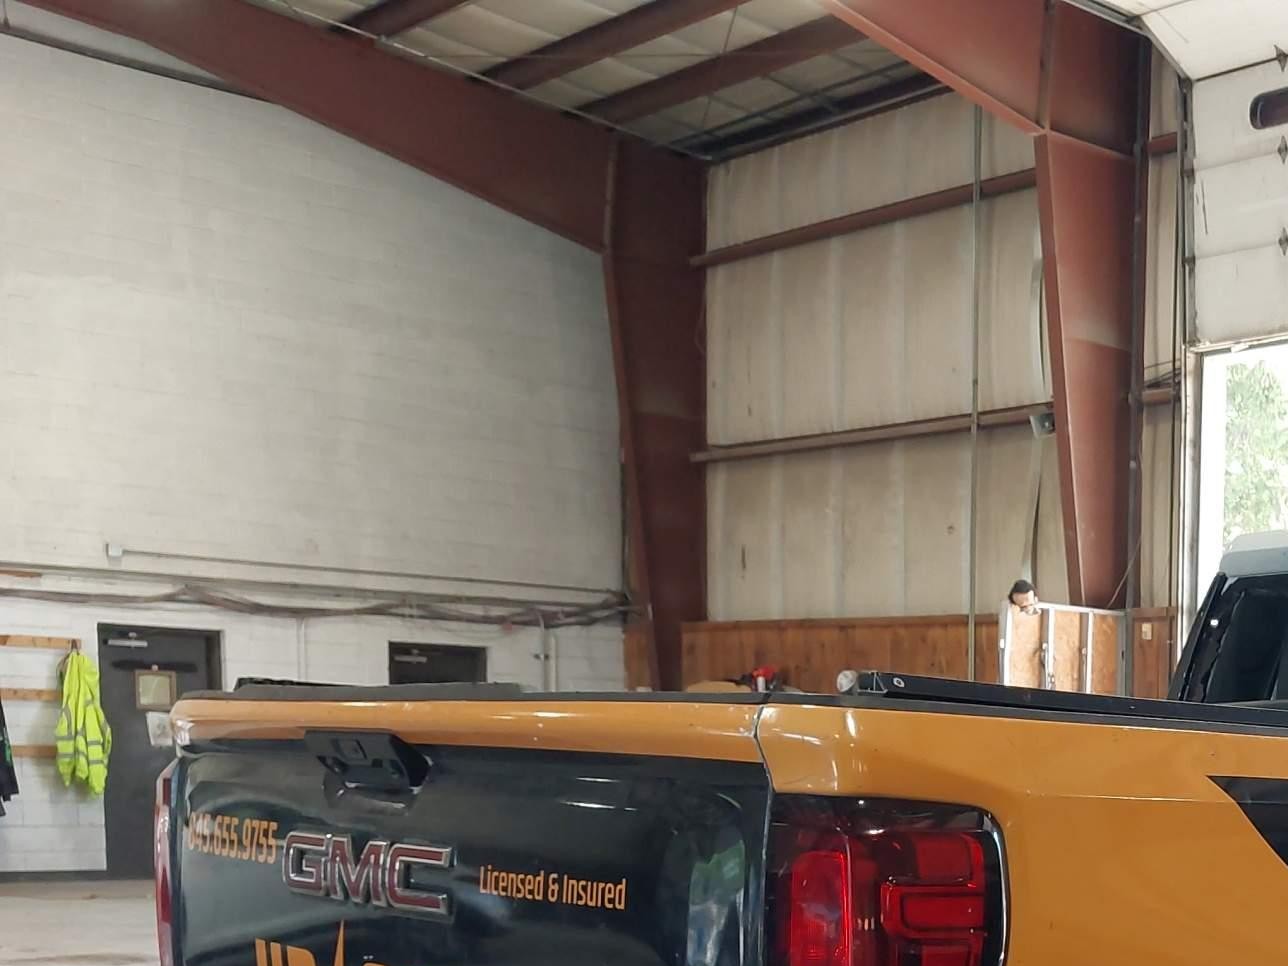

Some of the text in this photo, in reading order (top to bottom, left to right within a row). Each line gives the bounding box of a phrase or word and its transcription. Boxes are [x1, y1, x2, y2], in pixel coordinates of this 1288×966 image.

[282, 831, 456, 916] GMC
[479, 864, 627, 910] Licensed & Insured
